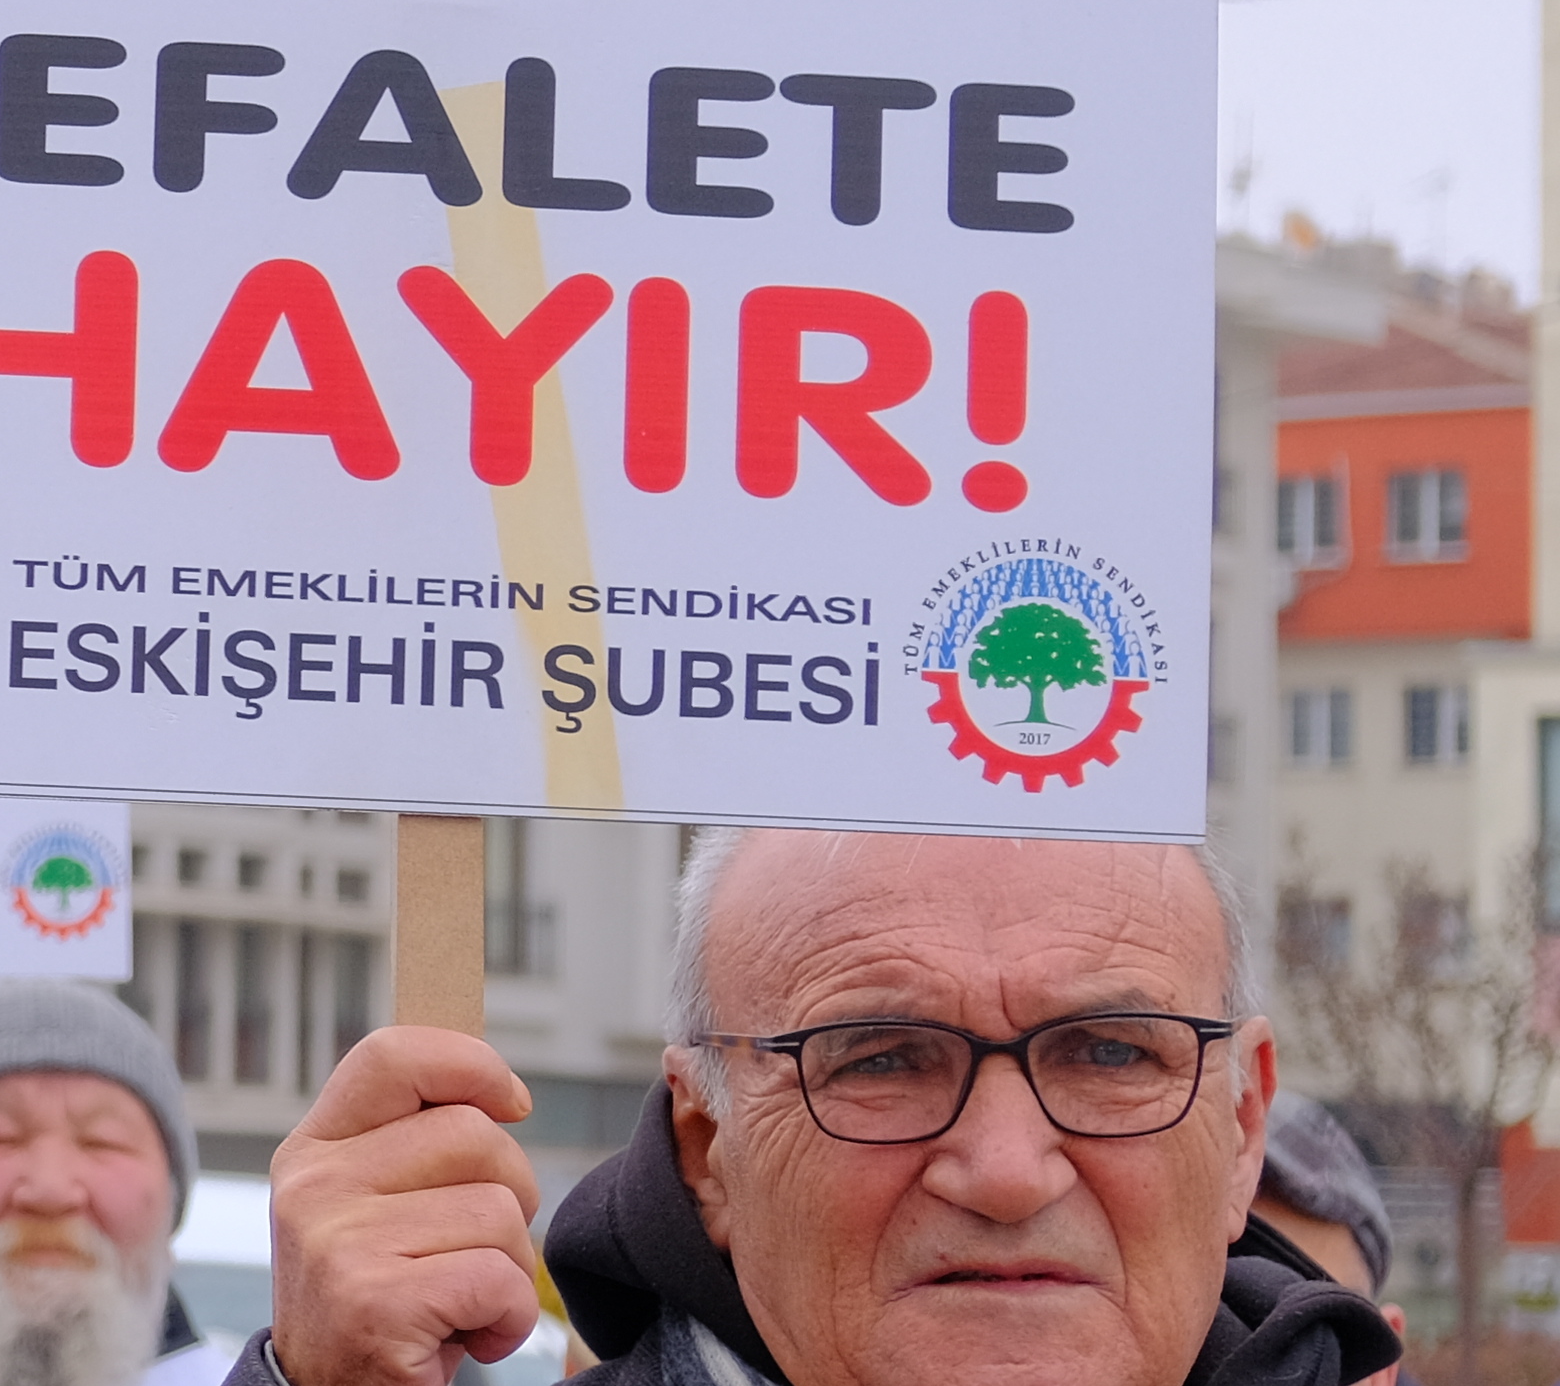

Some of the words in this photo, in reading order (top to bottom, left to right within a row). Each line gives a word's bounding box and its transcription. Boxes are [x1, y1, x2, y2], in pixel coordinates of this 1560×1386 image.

[13, 558, 147, 596] TÜM
[172, 565, 545, 612] EMEKLİLERİN
[569, 579, 873, 626] SENDİKASI
[903, 622, 926, 676] TÜM
[922, 537, 1082, 611] EMEKLİLERİN
[1092, 557, 1168, 684] SENDİKASI
[7, 613, 505, 721] ESKİŞEHİR
[544, 639, 882, 733] ŞUBESİ
[1018, 732, 1051, 746] 2017
